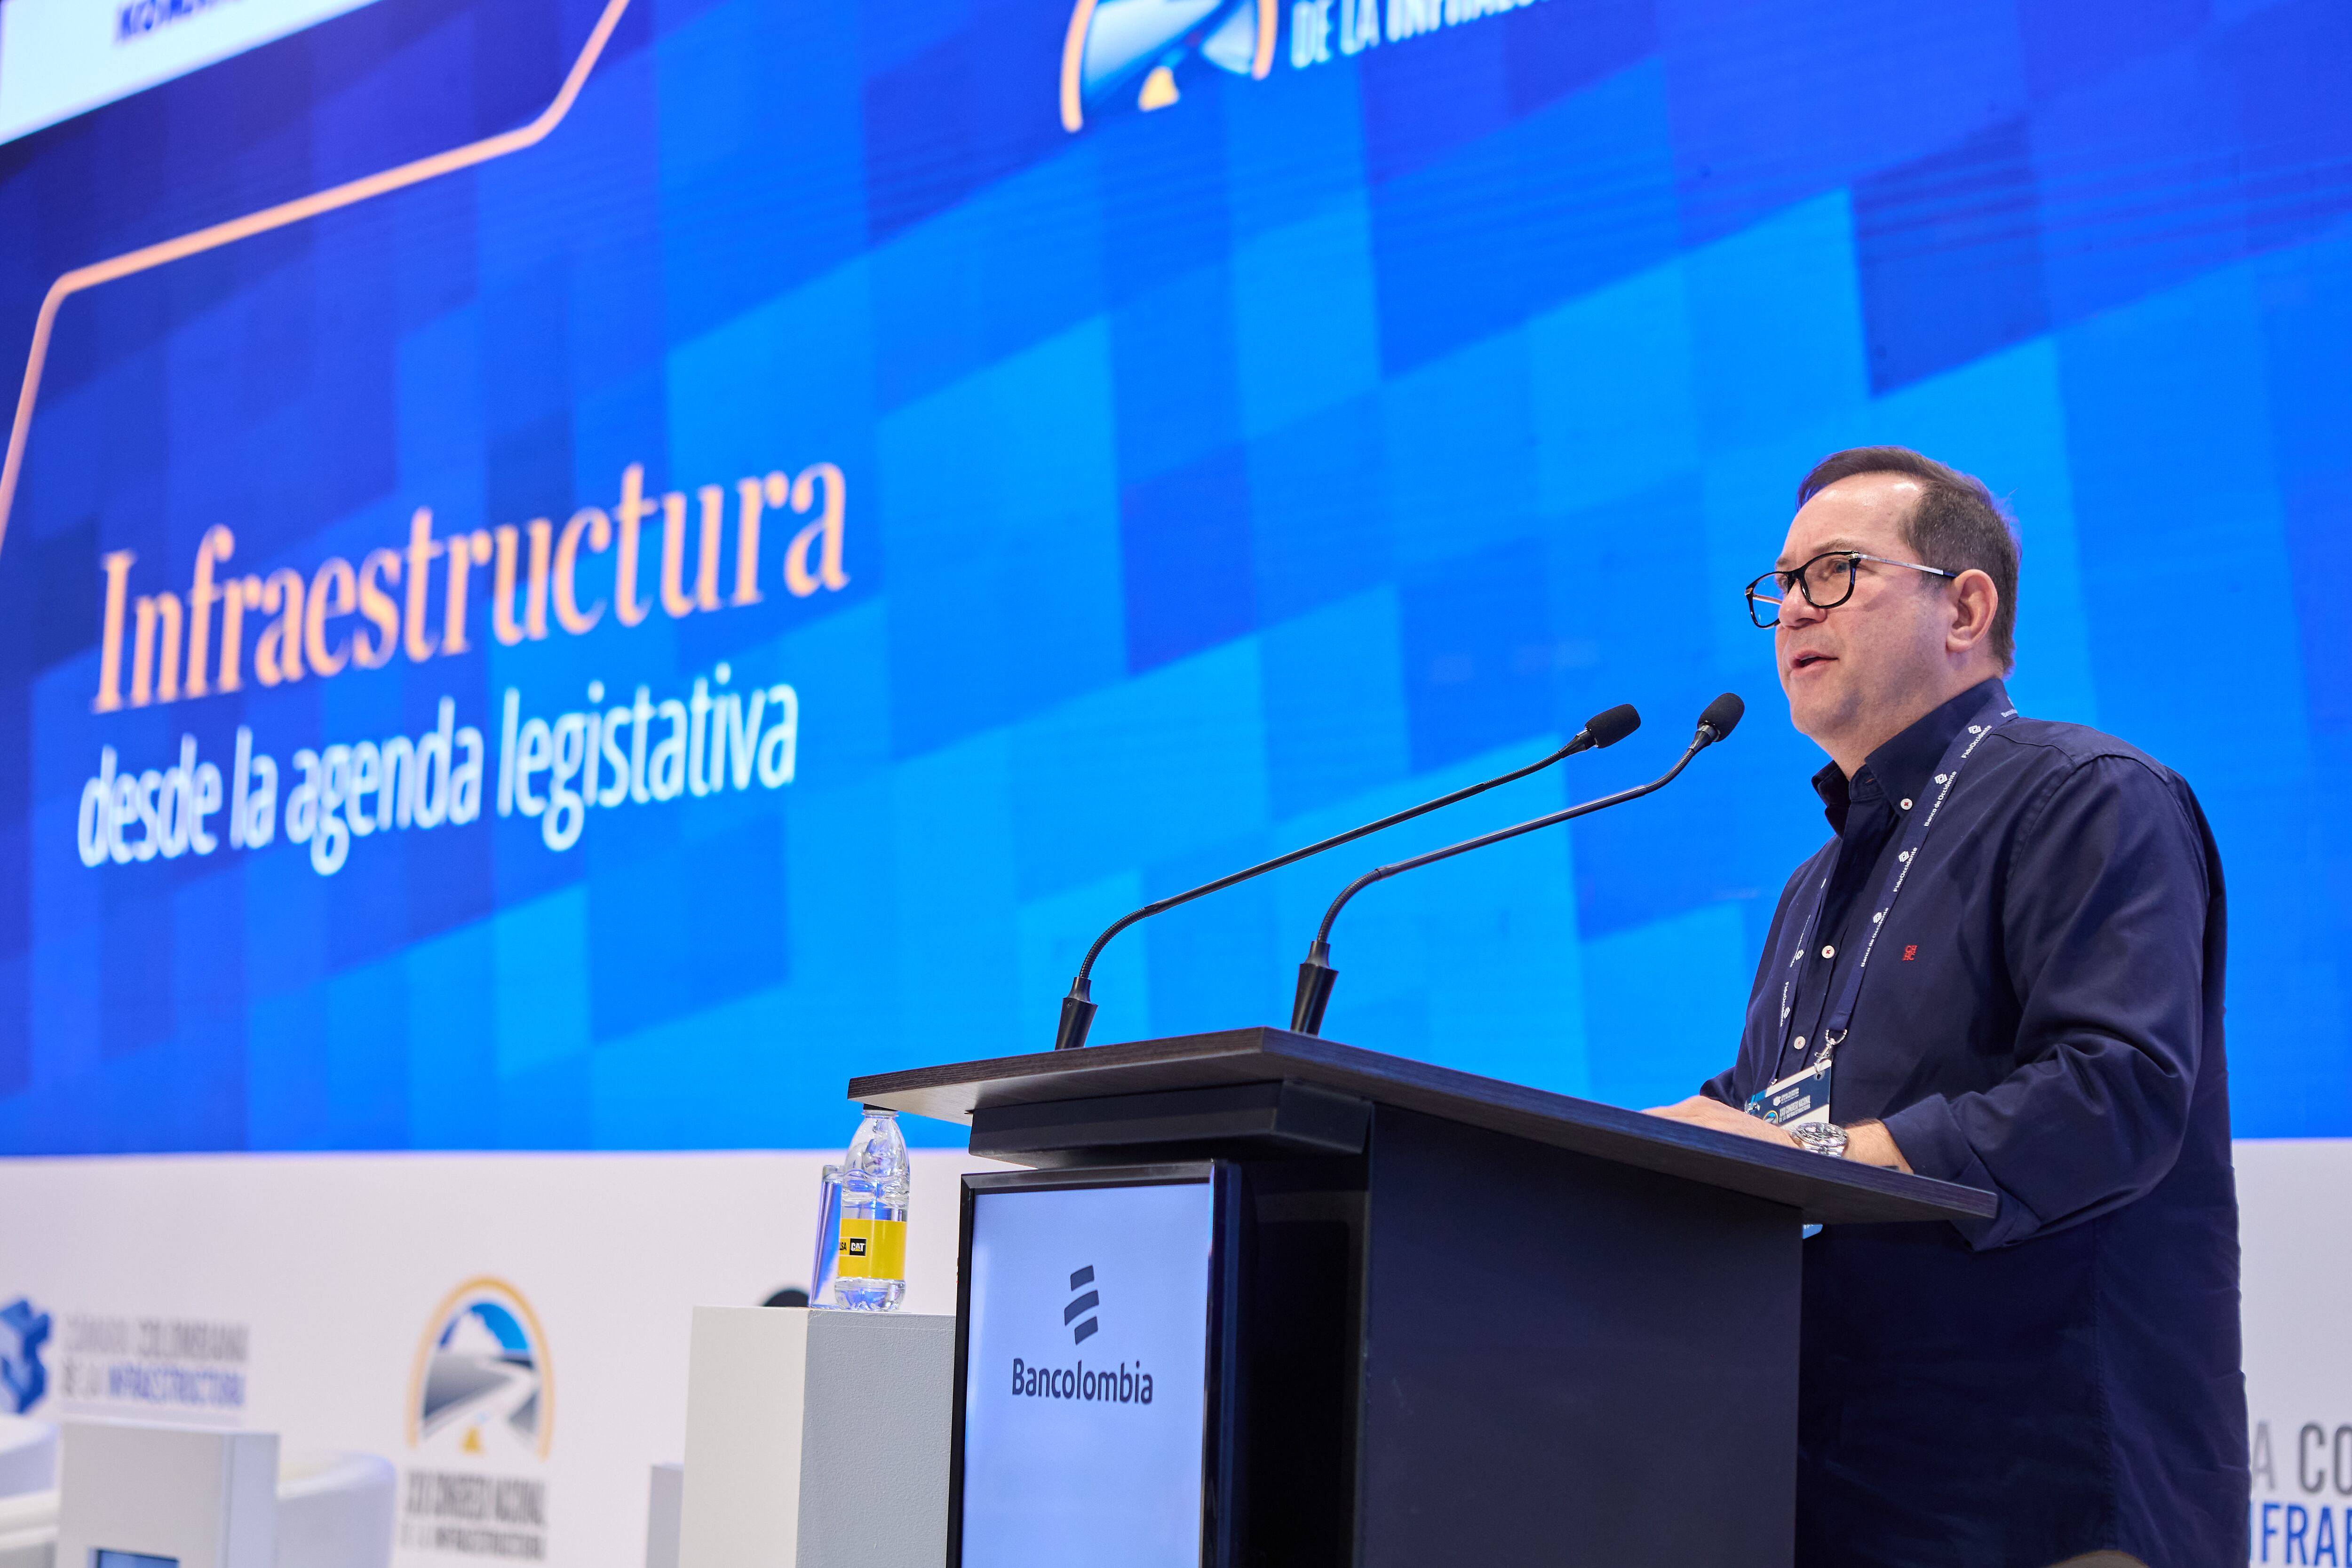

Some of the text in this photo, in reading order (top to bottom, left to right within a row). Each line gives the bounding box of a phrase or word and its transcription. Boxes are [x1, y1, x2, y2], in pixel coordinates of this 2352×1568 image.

[91, 461, 850, 713] Infraestructura
[77, 661, 798, 876] desde la agenda legistativa
[1924, 808, 1937, 827] Banco
[1938, 771, 1957, 800] Occidente
[1860, 947, 1871, 967] Banco
[1872, 907, 1889, 939] Occidente
[850, 1242, 865, 1251] CAT
[1012, 1357, 1153, 1405] Bancolombia
[2251, 1502, 2352, 1568] FRA
